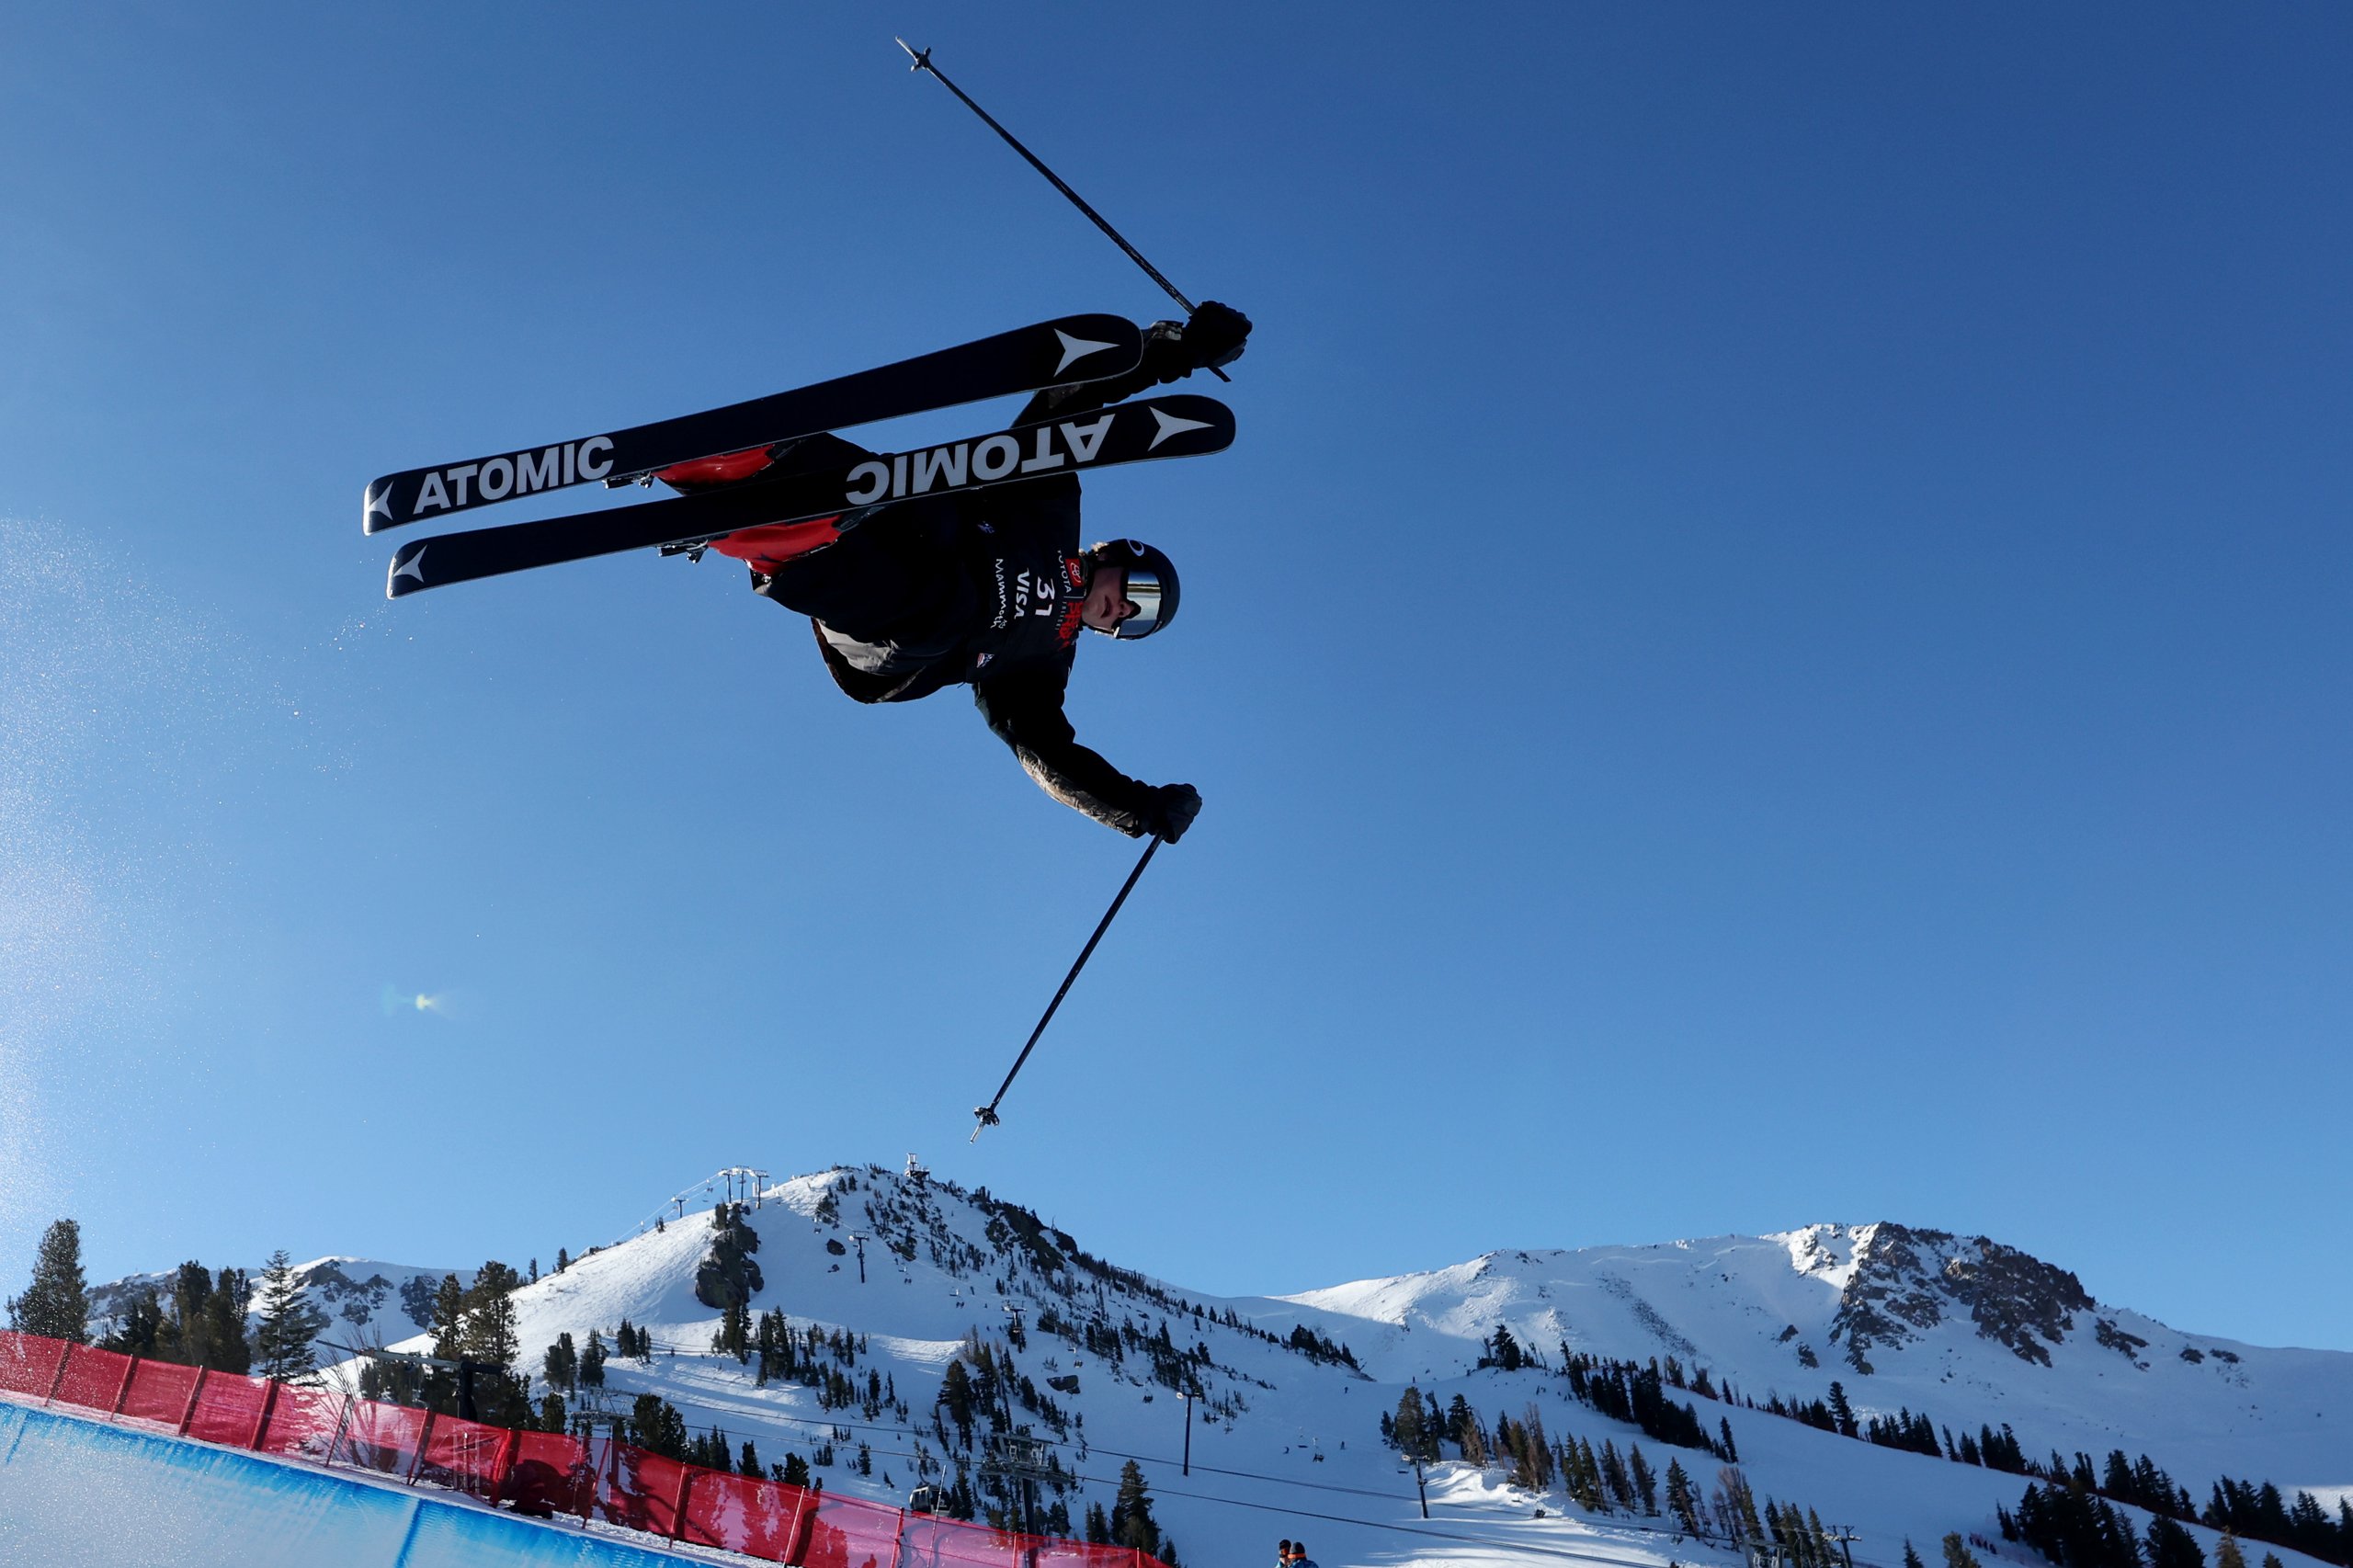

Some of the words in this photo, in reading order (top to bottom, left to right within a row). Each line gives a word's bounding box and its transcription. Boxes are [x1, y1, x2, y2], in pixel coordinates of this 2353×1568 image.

[413, 436, 615, 516] ATOMIC
[845, 414, 1116, 506] ATOMIC
[990, 558, 1007, 629] Mammoth
[1014, 567, 1030, 619] VISA
[1034, 575, 1056, 617] 31
